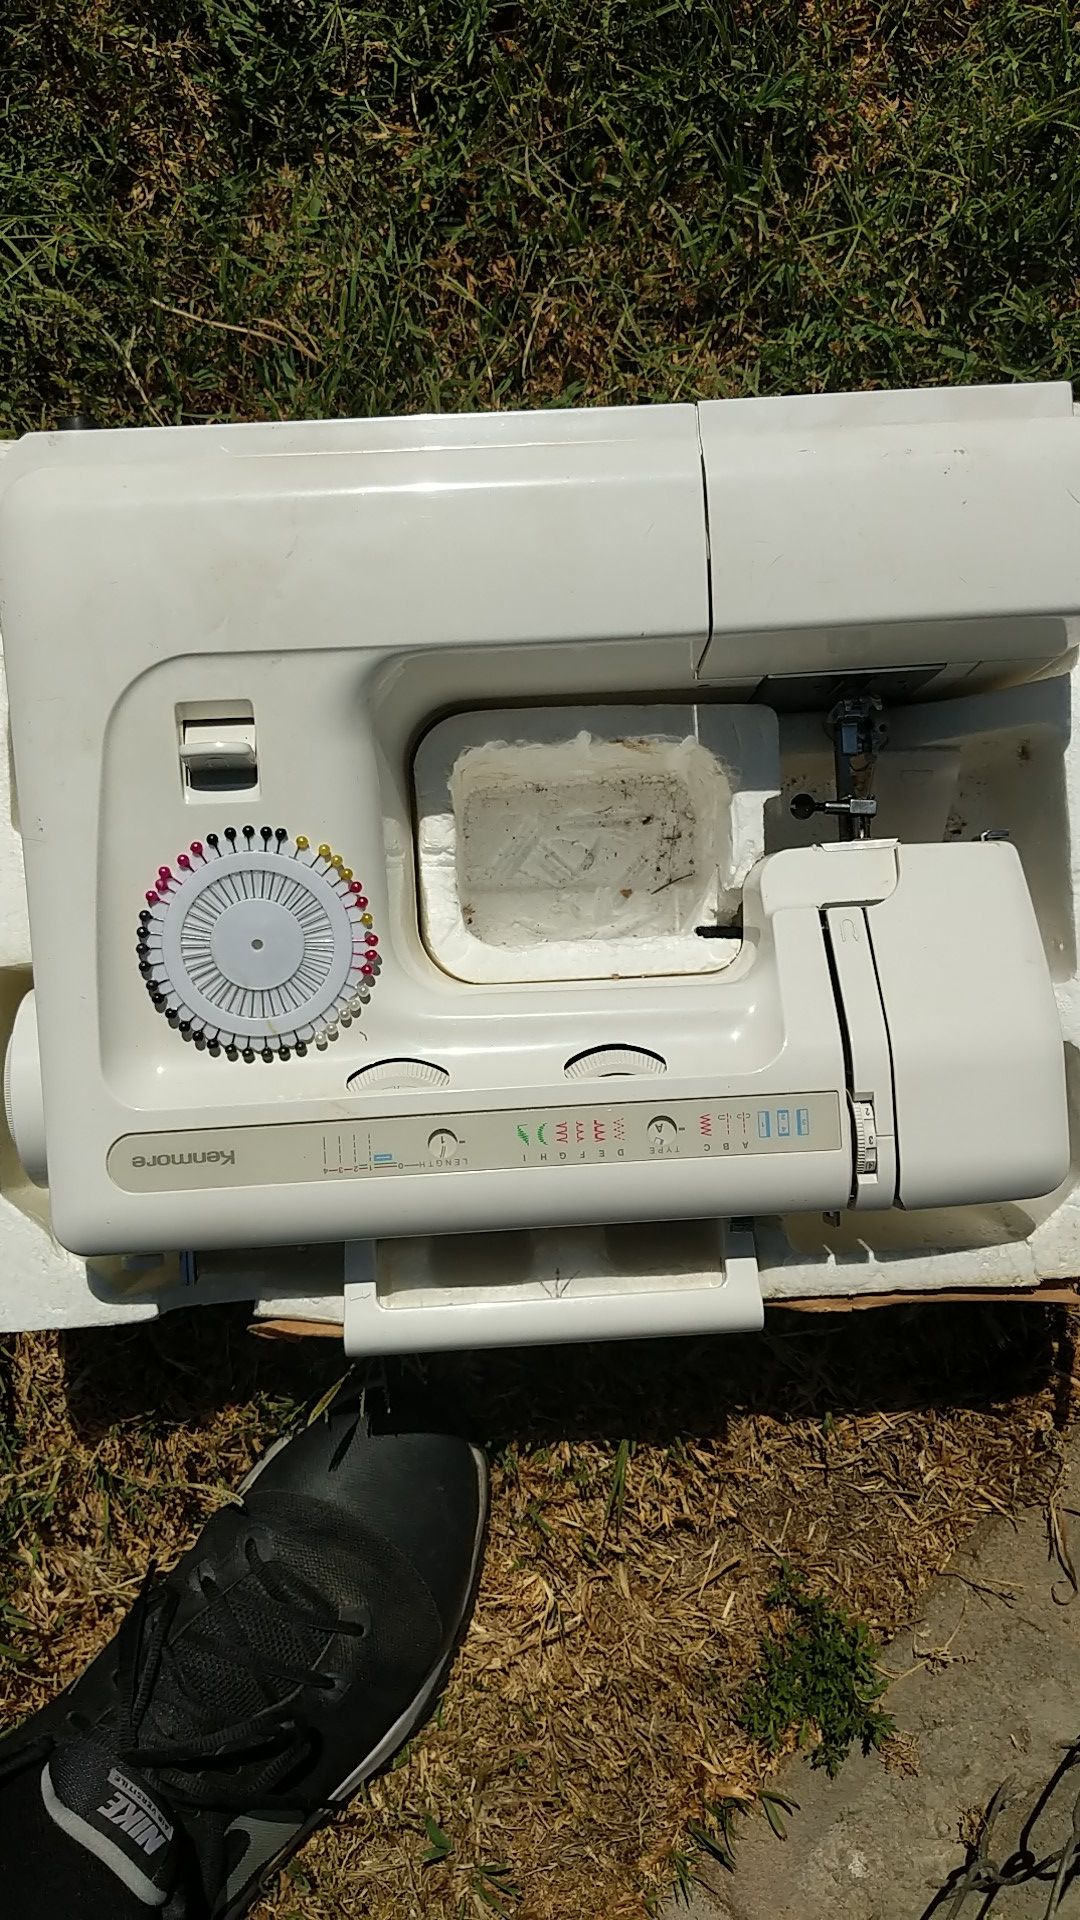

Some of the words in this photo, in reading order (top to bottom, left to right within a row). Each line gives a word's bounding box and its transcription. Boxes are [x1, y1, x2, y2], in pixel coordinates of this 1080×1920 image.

[865, 1107, 870, 1116] 2
[655, 1123, 664, 1134] A
[868, 1135, 874, 1144] 3
[703, 1143, 711, 1151] C
[722, 1142, 730, 1150] B
[742, 1140, 749, 1149] A
[617, 1148, 625, 1156] D
[649, 1146, 680, 1154] TYPE
[132, 1150, 236, 1168] Kenmore
[579, 1151, 586, 1159] F
[418, 1157, 469, 1168] LENGTH
[97, 1791, 167, 1856] NIKE
